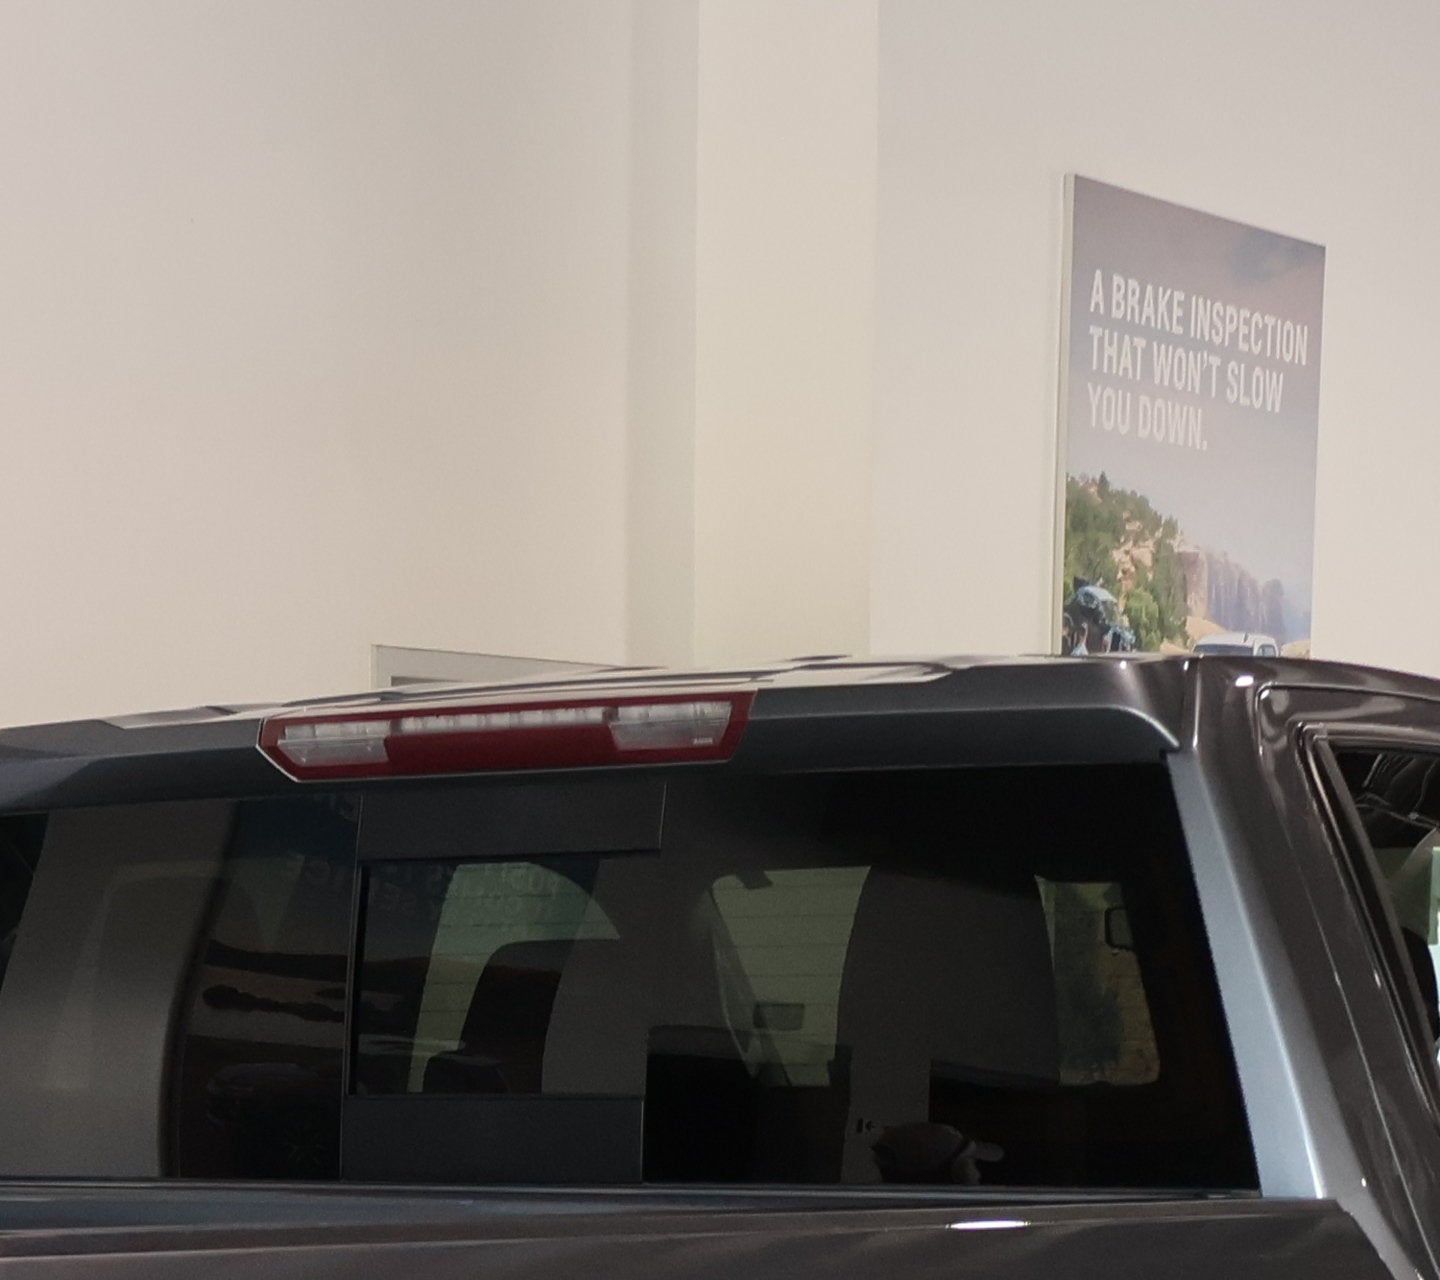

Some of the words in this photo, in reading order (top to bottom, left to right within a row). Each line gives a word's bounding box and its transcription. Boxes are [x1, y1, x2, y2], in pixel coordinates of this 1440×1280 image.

[1090, 269, 1104, 315] A
[1111, 273, 1185, 335] BRAKE
[1190, 295, 1308, 366] INSPECTION
[1089, 325, 1146, 380] THAT
[1153, 342, 1221, 398] WON'T
[1227, 361, 1284, 413] SLOW
[1088, 382, 1131, 435] YOU
[1138, 395, 1208, 450] DOWN.
